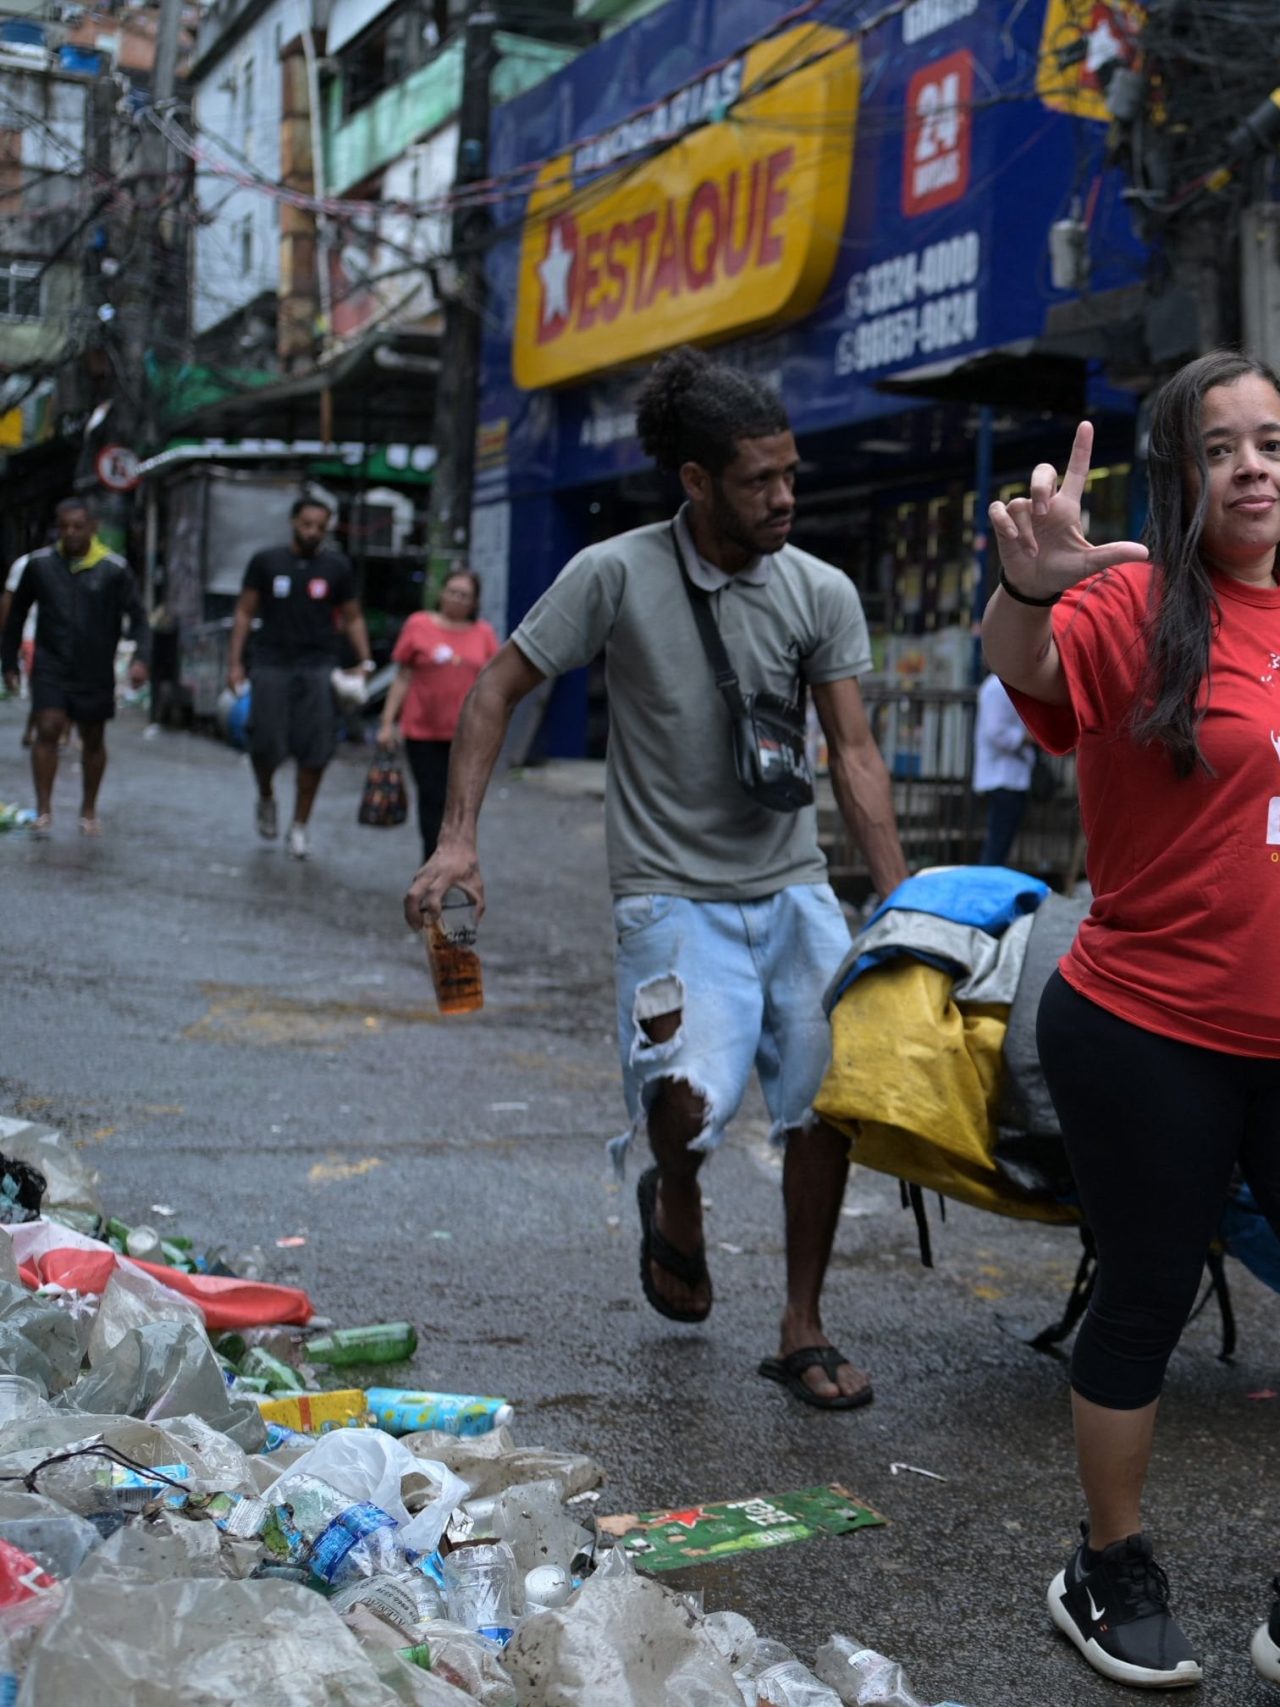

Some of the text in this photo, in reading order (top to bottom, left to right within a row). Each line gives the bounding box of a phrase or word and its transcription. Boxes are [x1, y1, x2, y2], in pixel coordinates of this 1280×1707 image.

[913, 72, 960, 162] 24
[536, 148, 794, 343] DESTAQUE
[1271, 852, 1279, 862] O
